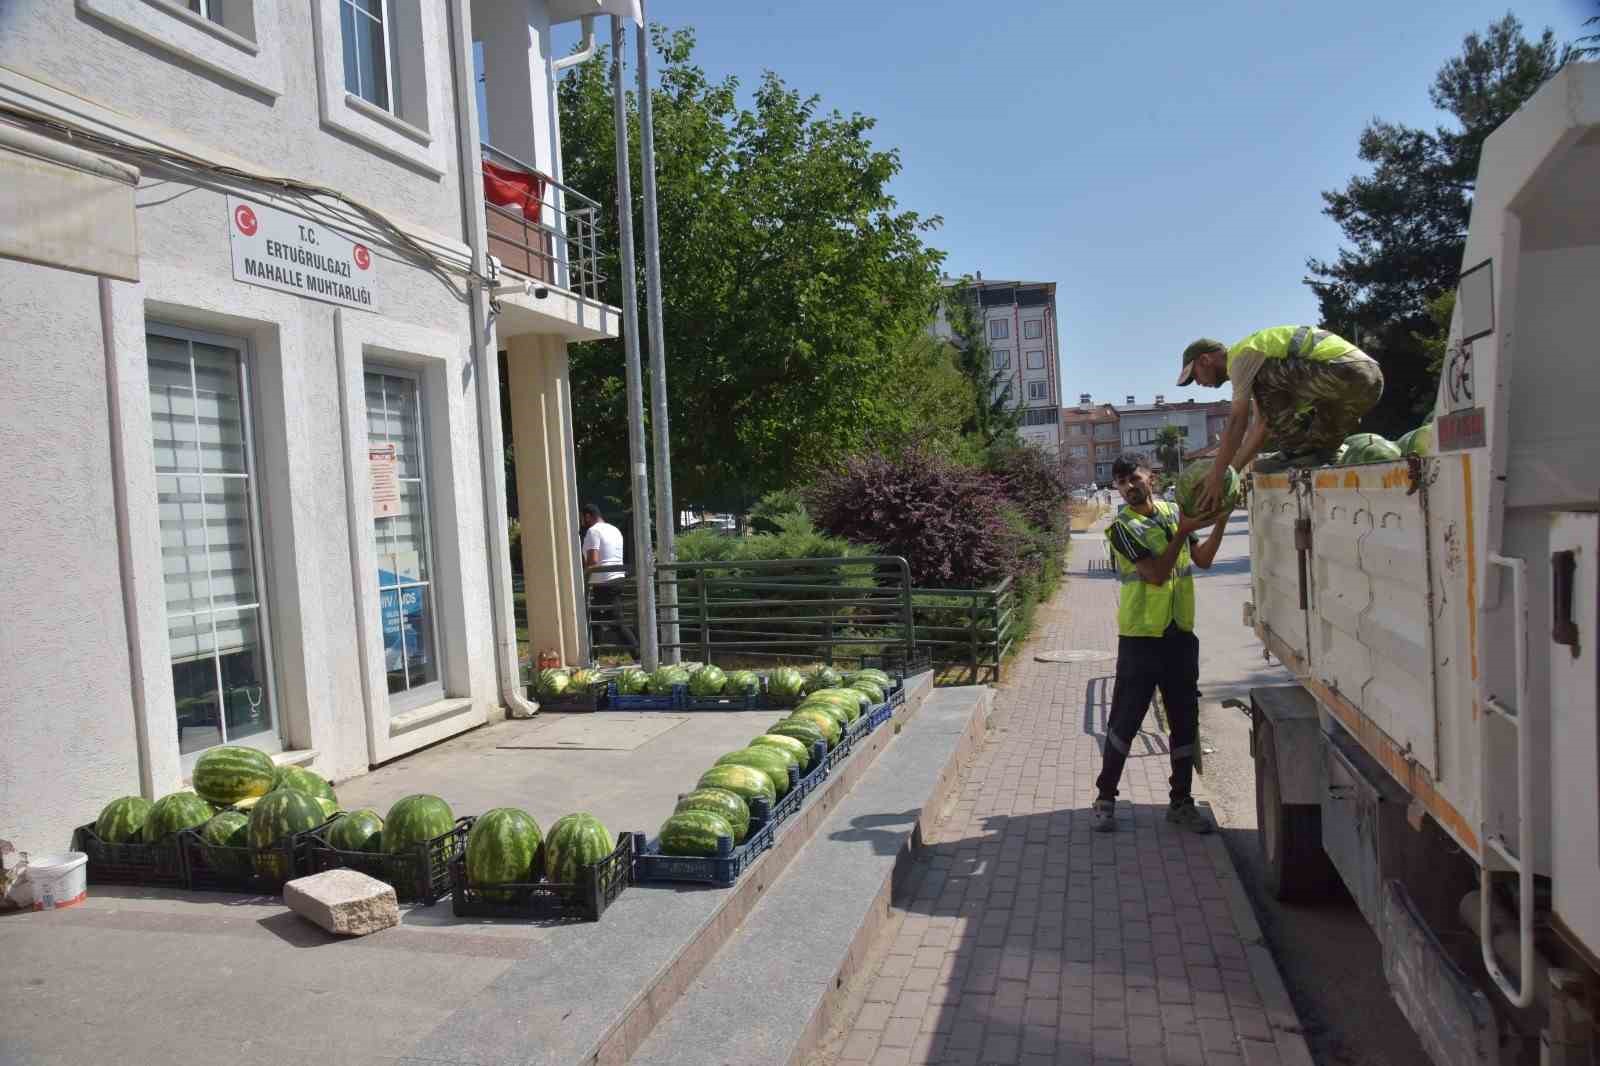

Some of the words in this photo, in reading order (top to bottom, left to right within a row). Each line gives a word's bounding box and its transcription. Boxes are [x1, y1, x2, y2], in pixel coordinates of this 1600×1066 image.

[298, 224, 320, 246] T.C.
[266, 239, 352, 278] ERTUĞRULGAZİ
[244, 257, 304, 288] MAHALLE
[306, 274, 372, 305] MUHTARLIĞI
